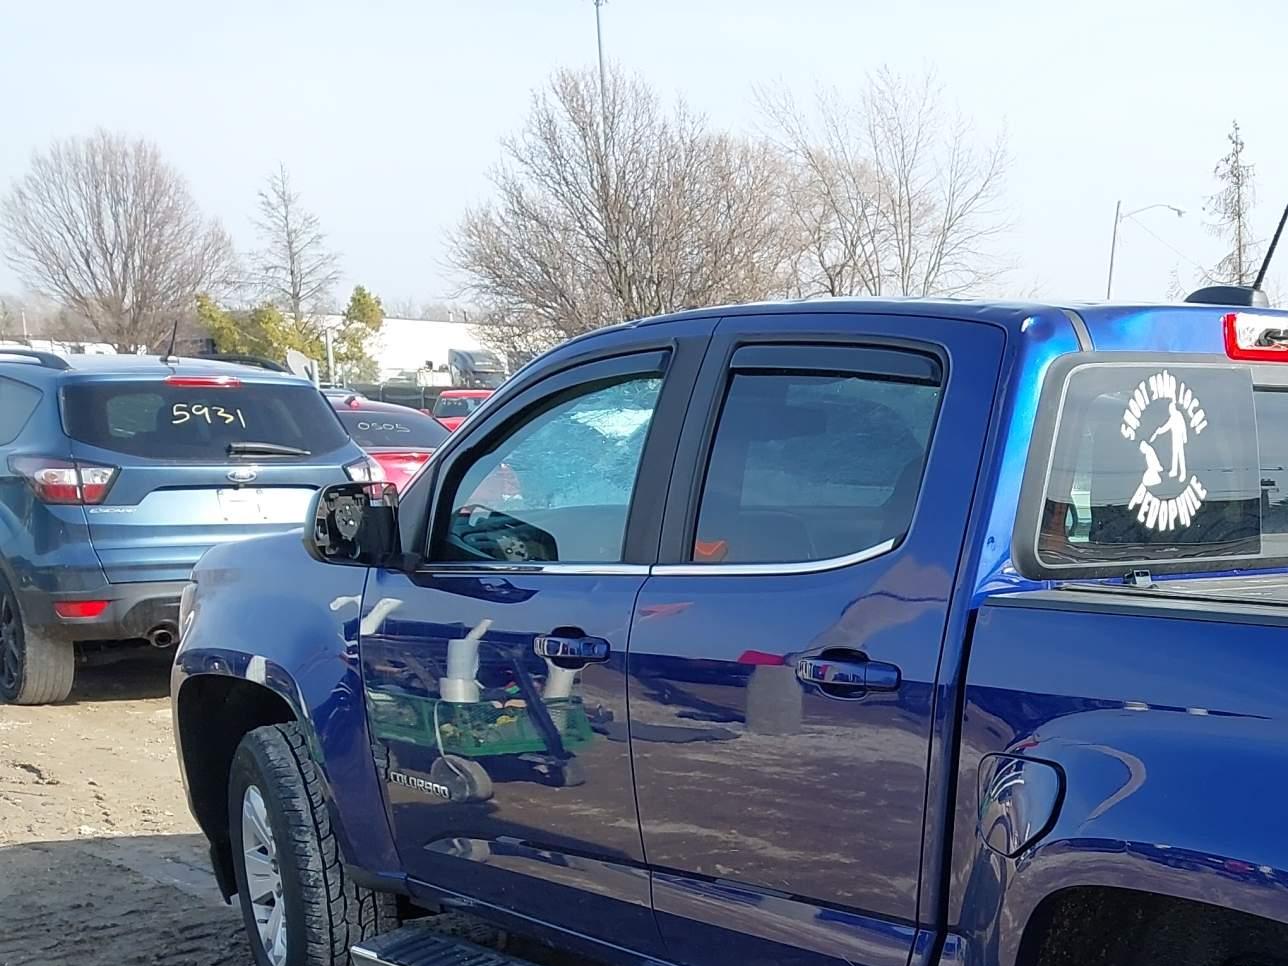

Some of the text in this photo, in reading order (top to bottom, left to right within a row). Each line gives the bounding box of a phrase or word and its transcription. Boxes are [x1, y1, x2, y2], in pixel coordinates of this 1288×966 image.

[171, 403, 246, 429] 5931
[1120, 380, 1150, 441] SHOOT
[1177, 382, 1208, 434] LOCAL
[1127, 475, 1208, 532] PEDOPHILE
[390, 771, 450, 799] COLORADO
